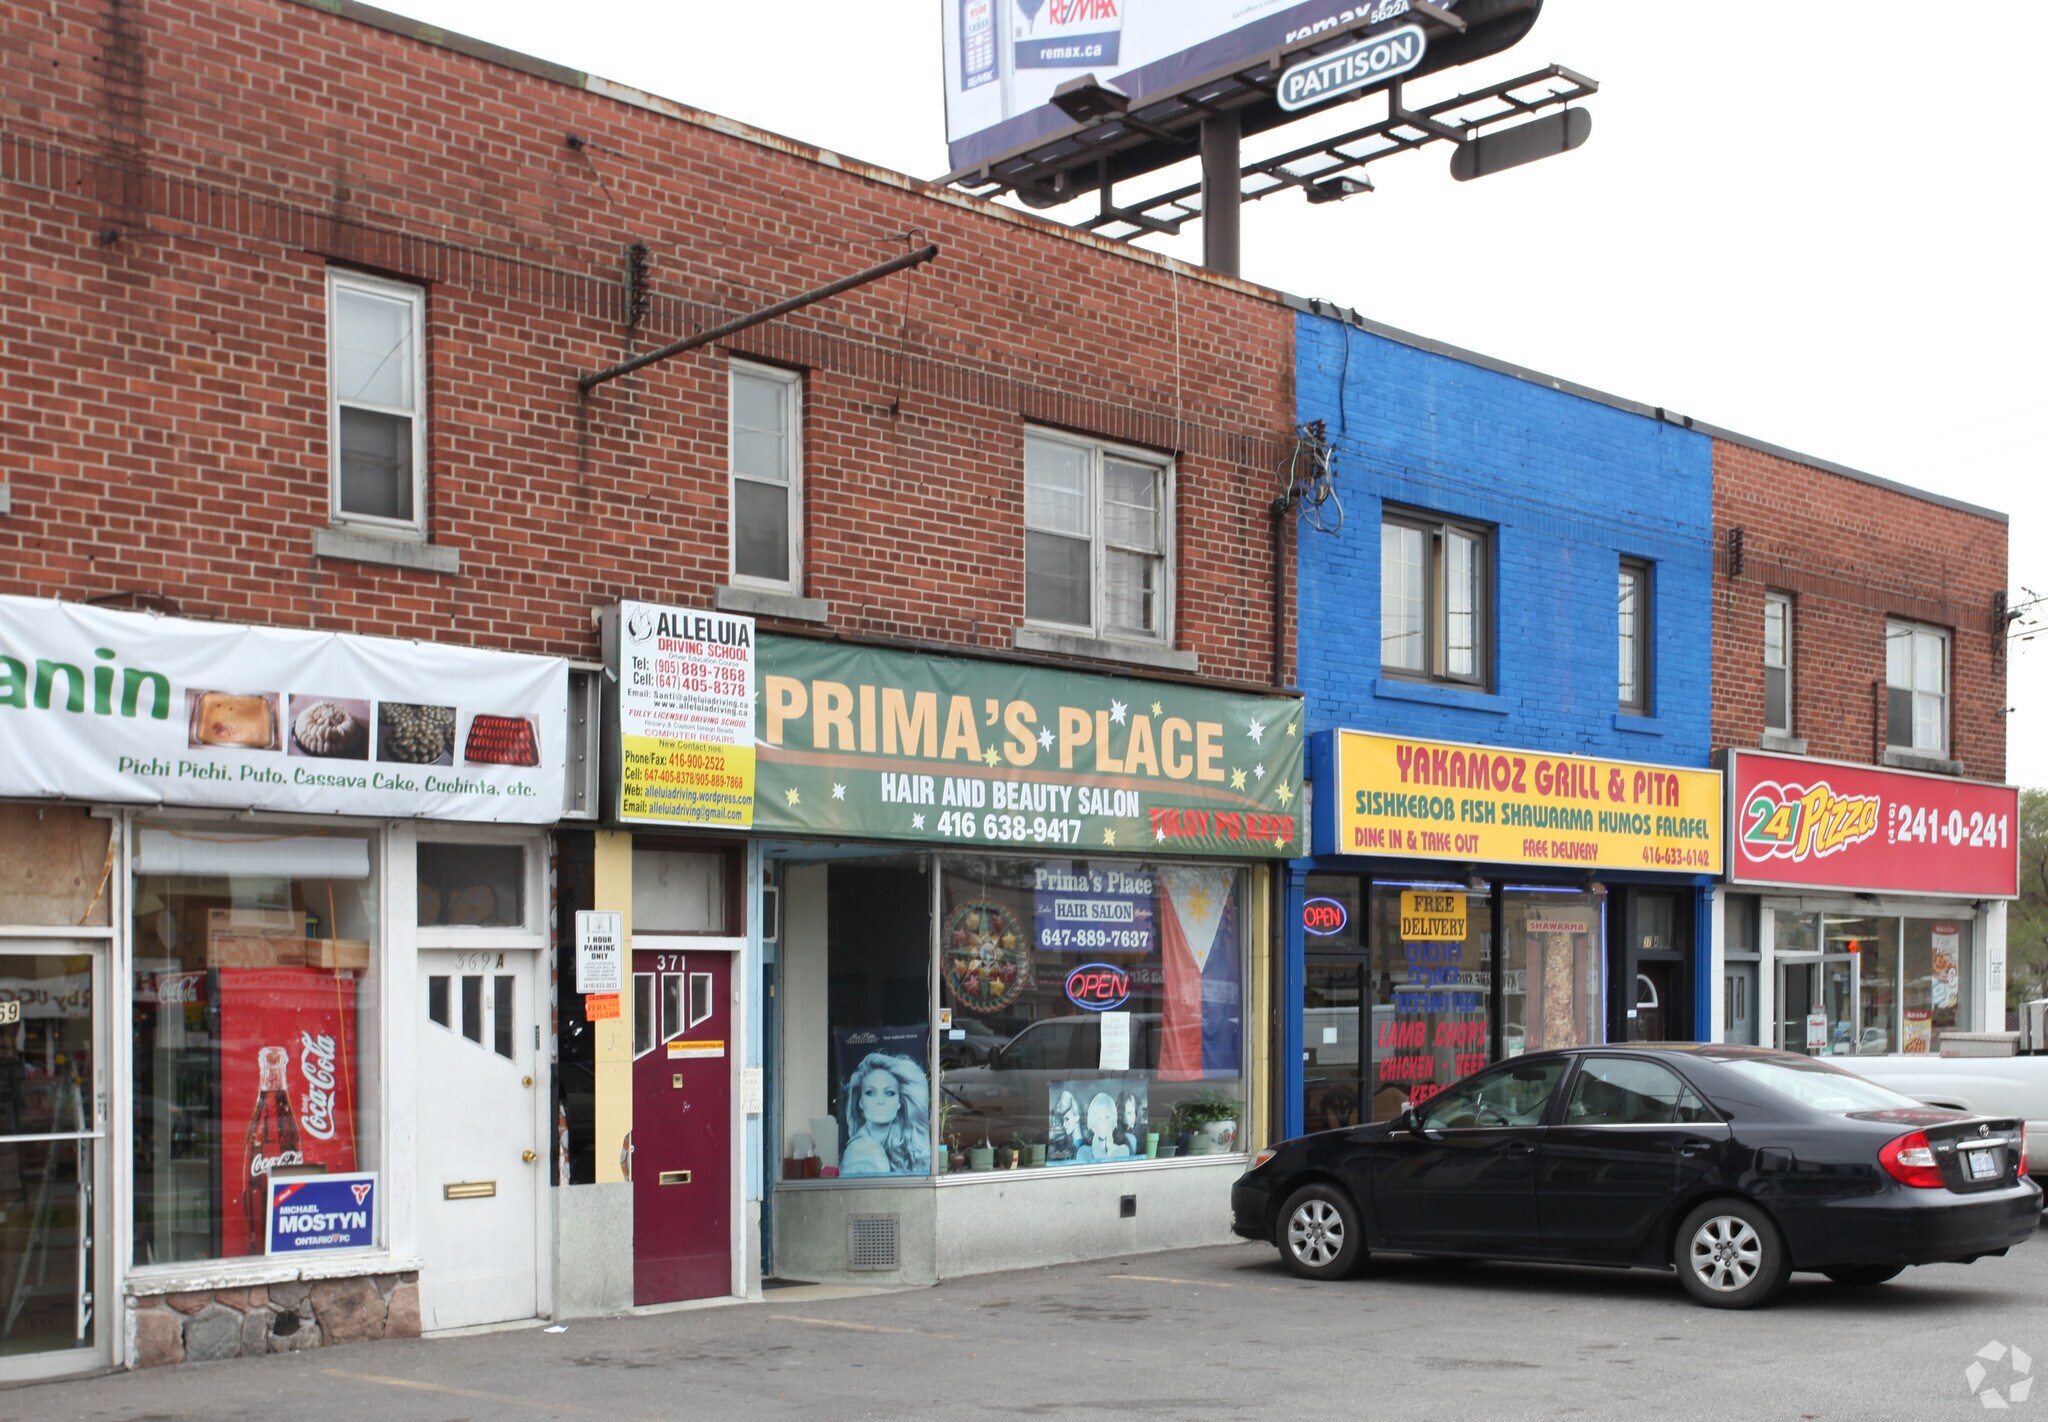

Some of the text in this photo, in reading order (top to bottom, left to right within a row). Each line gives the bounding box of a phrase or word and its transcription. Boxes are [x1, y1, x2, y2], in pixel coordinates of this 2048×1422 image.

[1370, 2, 1409, 24] 5622A
[1040, 44, 1102, 60] remax.ca
[1290, 36, 1412, 101] PATTISON
[656, 611, 750, 648] ALLELUIA
[658, 638, 749, 662] DRIVING SCHOOL
[668, 652, 687, 661] Driver
[718, 658, 740, 668] Course
[632, 656, 746, 683] Tel: (905) 889-7868
[627, 688, 652, 699] Email:
[633, 671, 746, 698] Cell: (647) 405-8378
[628, 708, 748, 728] FULLY LICENSED DRIVING SCHOOL
[653, 699, 749, 717] www.alleluiadriving.ca
[644, 727, 737, 745] COMPUTER REPAIRS
[765, 675, 1225, 782] PRIMA'S PLACE
[658, 739, 724, 754] New Contact nos:
[668, 752, 725, 772] 416-900-2522
[118, 756, 170, 777] Pichi
[294, 767, 367, 789] Cassava
[507, 781, 536, 797] etc.
[624, 766, 643, 781] Cell:
[1396, 745, 1680, 808] YAKAMOZ GRILL & PITA
[624, 783, 753, 806] Web: alleluiadriving.wordpress.com
[881, 772, 1139, 818] HAIR AND BEAUTY SALON
[623, 799, 743, 821] Email: alleluiadriving@gmail.com
[1356, 790, 1710, 840] SISHKEBOB FISH SHAWARMA HUMOS FALAFEL
[1794, 782, 1880, 859] Pizza
[937, 810, 1082, 844] 416 638-9417
[1148, 807, 1210, 838] TULOY
[1215, 811, 1241, 840] PO
[1897, 804, 2008, 849] 241-0-241
[1355, 826, 1479, 854] DINE IN & TAKE OUT
[1523, 838, 1599, 861] FREE DELIVERY
[1642, 845, 1710, 867] 416-633-6142
[1035, 868, 1153, 895] Prima's Place
[1056, 902, 1089, 918] HAIR
[1091, 903, 1132, 920] SALON
[1413, 895, 1455, 912] FREE
[1303, 906, 1341, 927] OPEN
[1402, 917, 1466, 936] DELIVERY
[1530, 921, 1585, 931] SHAWARMA
[584, 944, 616, 952] PARKING
[593, 935, 613, 944] HOUR
[1041, 928, 1150, 948] 647-889-7637
[591, 952, 609, 960] ONLY
[657, 954, 686, 971] 371
[1068, 972, 1129, 999] OPEN
[1378, 1021, 1488, 1048] LAMB CHOPS
[1380, 1055, 1435, 1080] CHICKEN
[1455, 1053, 1485, 1077] BEEF
[280, 1204, 320, 1215] MICHAEL
[279, 1211, 367, 1234] MOSTYN
[295, 1234, 350, 1247] ONTARIO PC
